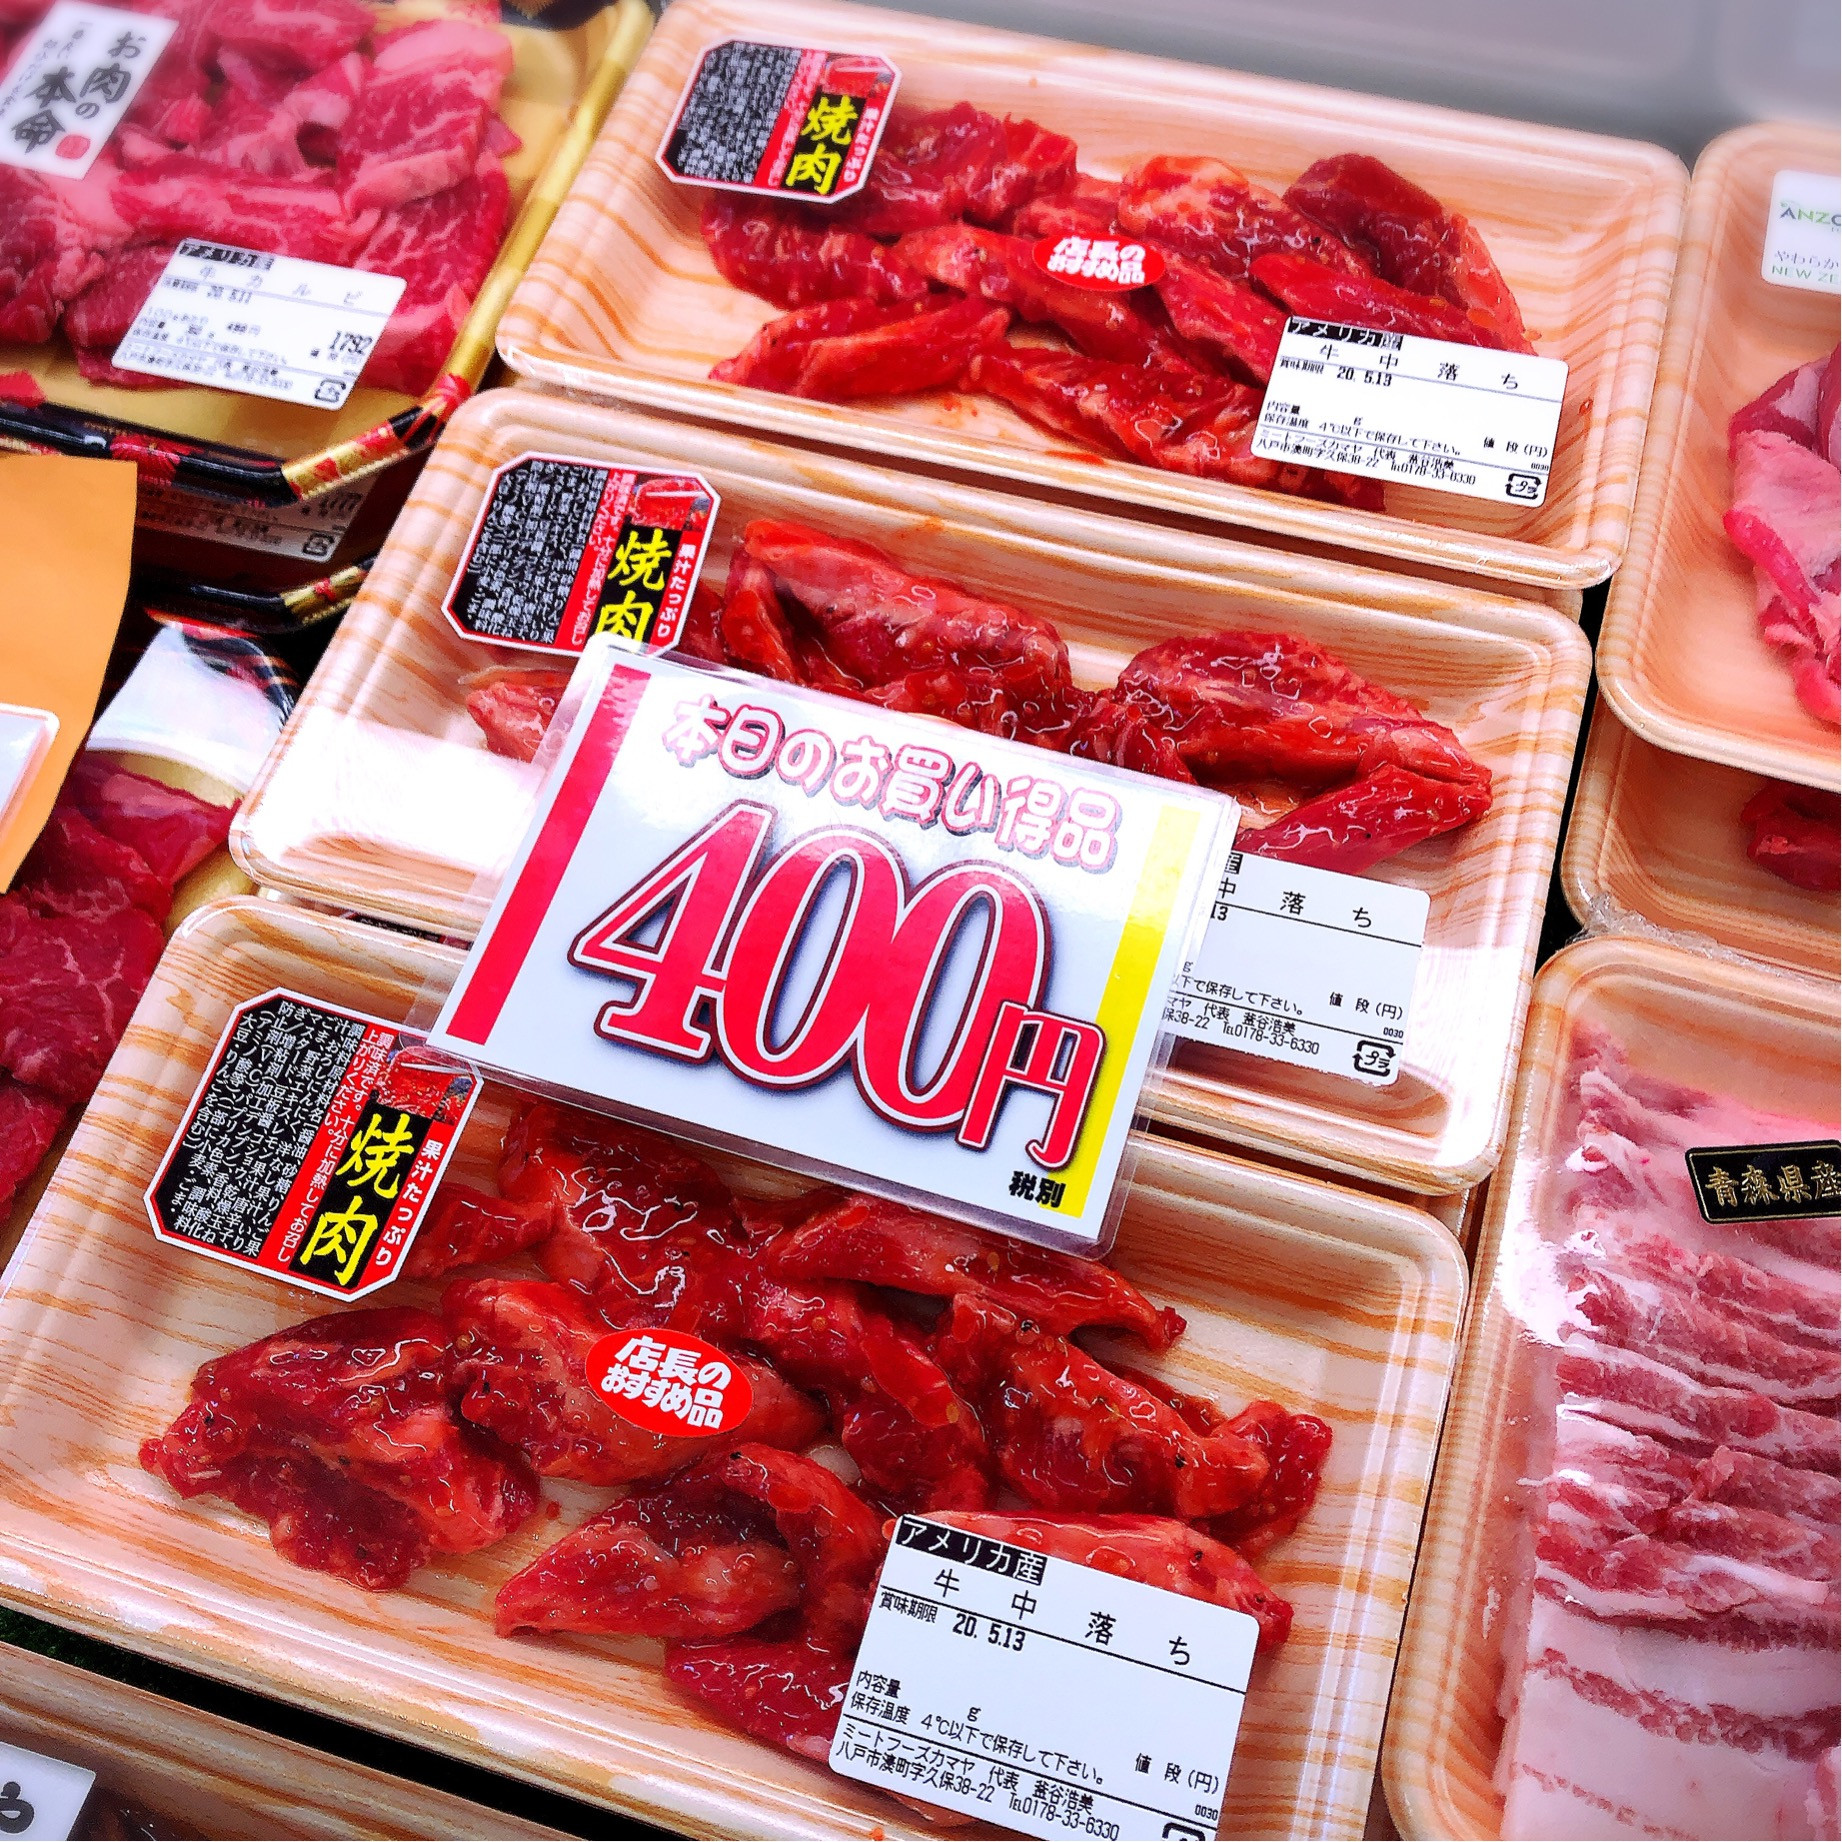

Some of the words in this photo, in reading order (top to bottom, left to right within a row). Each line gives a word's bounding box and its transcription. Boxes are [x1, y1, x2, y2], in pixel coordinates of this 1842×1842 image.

[75, 31, 147, 120] お肉の
[11, 66, 76, 155] 本命
[785, 94, 858, 195] 焼肉
[1053, 235, 1146, 261] 店長の
[1772, 265, 1812, 279] NEW
[1288, 318, 1403, 350] アメリカ産
[596, 527, 672, 650] 焼肉
[657, 543, 697, 638] 果汁たっぷり
[661, 696, 1122, 873] 本日のお買い得品
[568, 800, 1107, 1169] 400円
[1204, 1002, 1231, 1022] 代表
[1383, 1027, 1404, 1039] 0030
[324, 1029, 379, 1136] 上がりください。
[278, 1031, 395, 1263] 調味済です。十分に加熱してお召し
[300, 1113, 414, 1286] 焼肉
[375, 1139, 444, 1266] 果汁たっぷり
[1009, 1170, 1064, 1208] 税別
[1705, 1160, 1842, 1206] 青森県産
[614, 1335, 732, 1390] 店長の
[601, 1363, 724, 1430] おすすめ品
[898, 1519, 1046, 1585] アメリカ産
[880, 1591, 938, 1623] 賞味期限
[934, 1569, 960, 1598] 牛
[1011, 1590, 1037, 1620] 中
[1085, 1611, 1117, 1646] 落
[1168, 1637, 1191, 1666] ち
[850, 1691, 912, 1725] 保存温度
[855, 1671, 902, 1698] 内容量
[835, 1740, 996, 1804] 八戸市湊町字久保38-22
[843, 1722, 976, 1776] ミートフーズカマヤ
[988, 1765, 1020, 1792] 代表
[1135, 1752, 1152, 1774] 値
[1194, 1803, 1219, 1822] 0030
